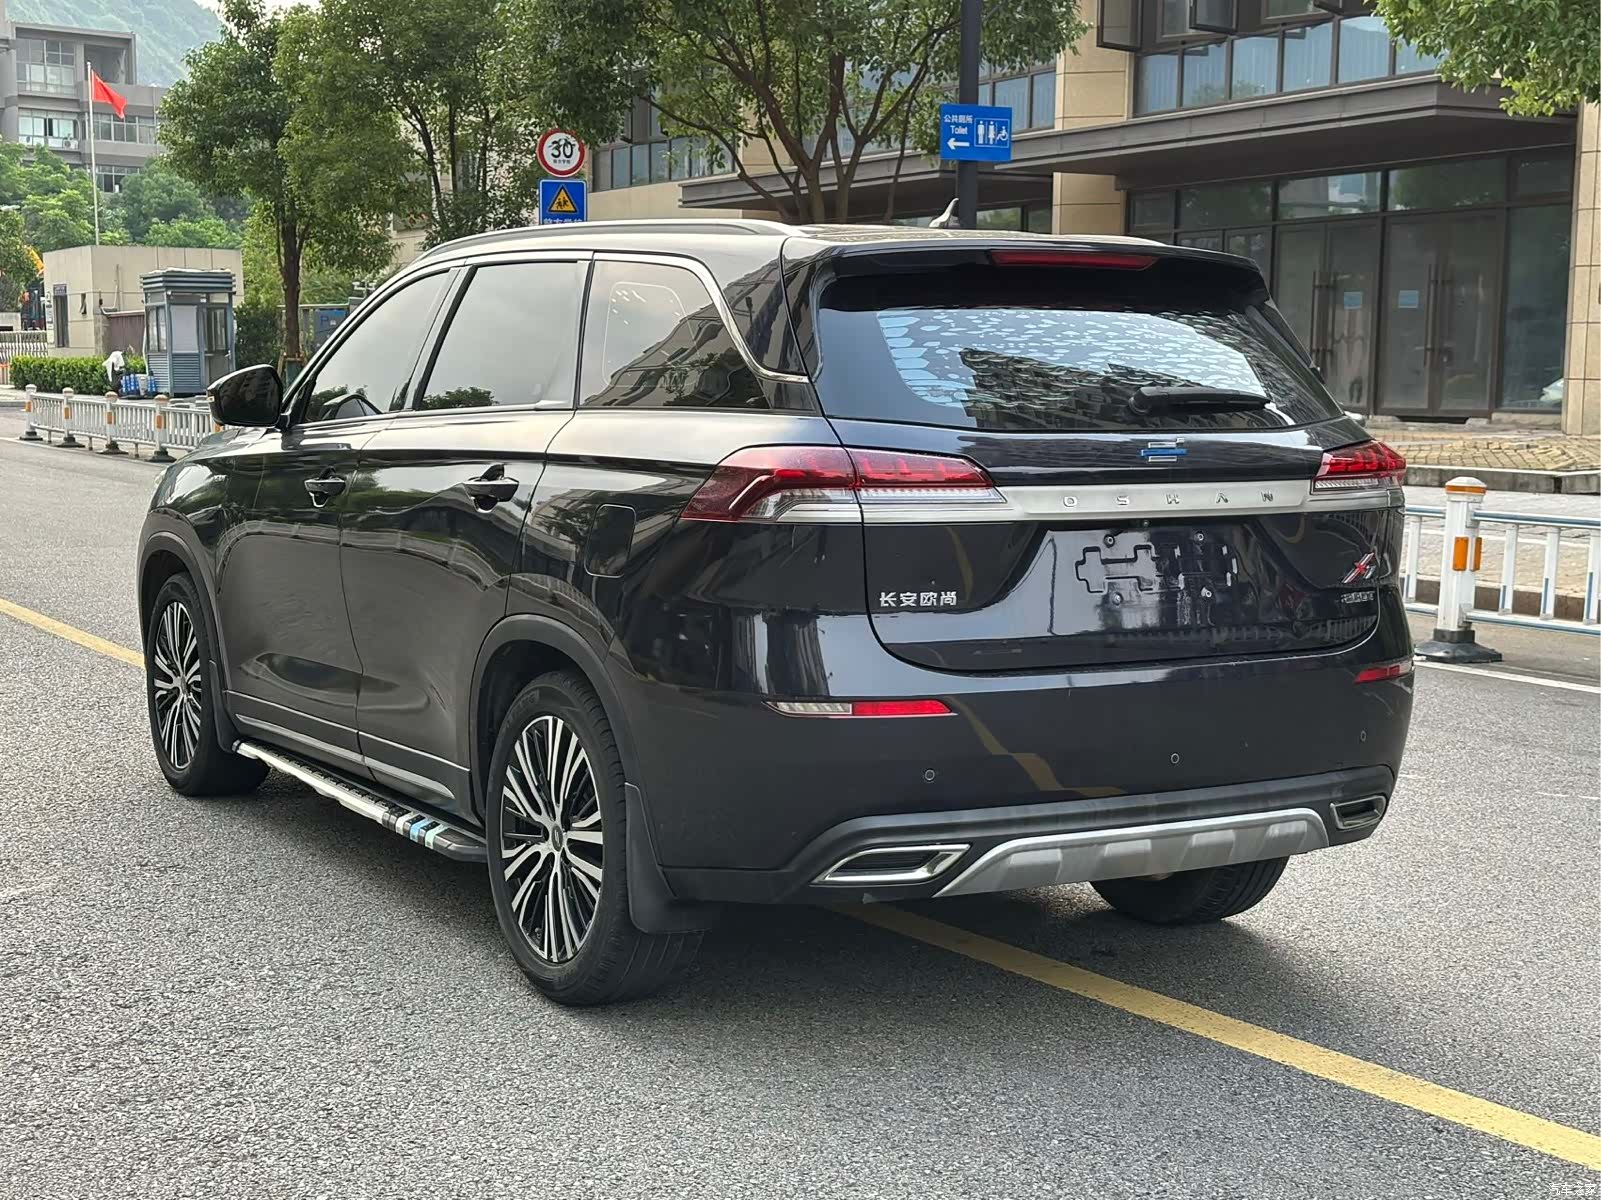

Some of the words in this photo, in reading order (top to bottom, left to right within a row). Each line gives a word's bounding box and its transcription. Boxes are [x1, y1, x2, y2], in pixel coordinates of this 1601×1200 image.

[950, 125, 968, 135] Toilet
[551, 140, 574, 158] 30
[1063, 490, 1274, 508] OSHAN
[879, 591, 957, 607] 长安欧尚
